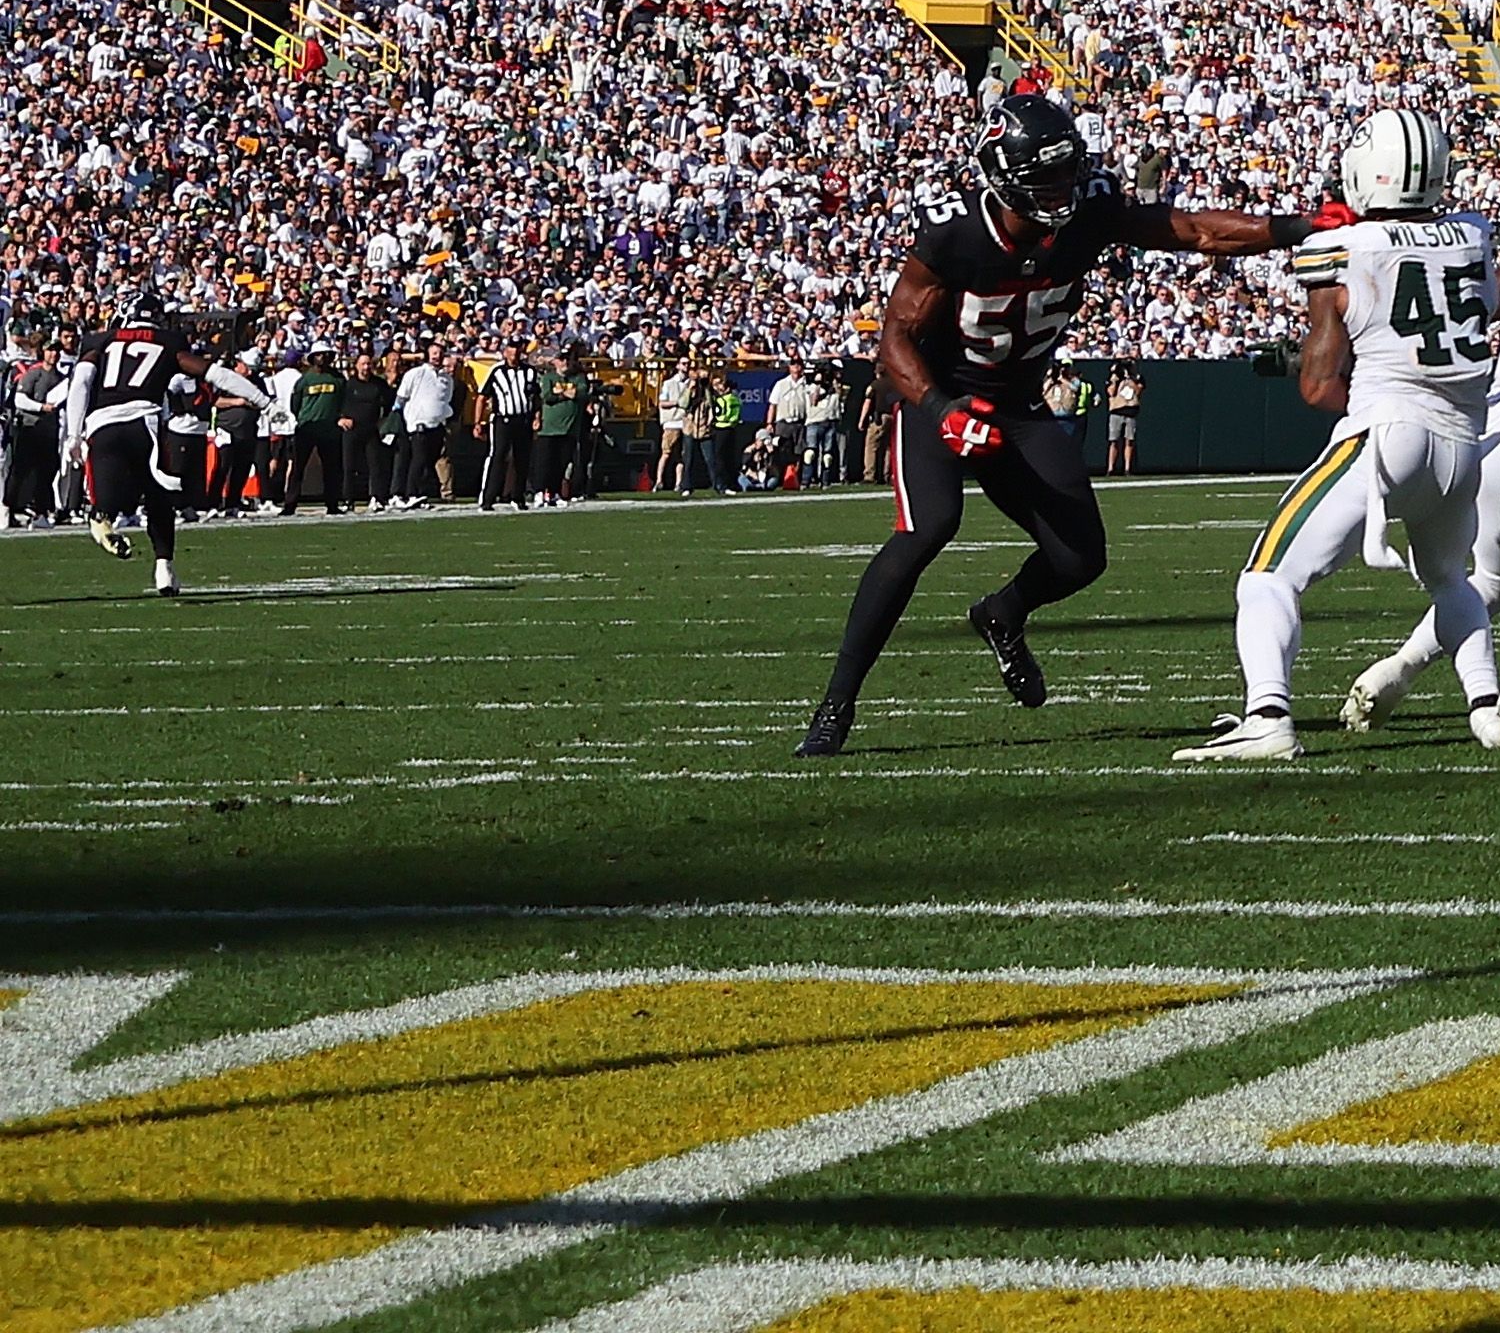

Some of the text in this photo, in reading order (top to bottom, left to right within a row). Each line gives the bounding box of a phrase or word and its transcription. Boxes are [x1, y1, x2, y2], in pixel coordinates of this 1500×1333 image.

[1088, 120, 1103, 136] 12
[1382, 220, 1470, 248] WILSON
[958, 280, 1076, 366] 55
[1389, 259, 1491, 367] 45
[104, 340, 165, 389] 17
